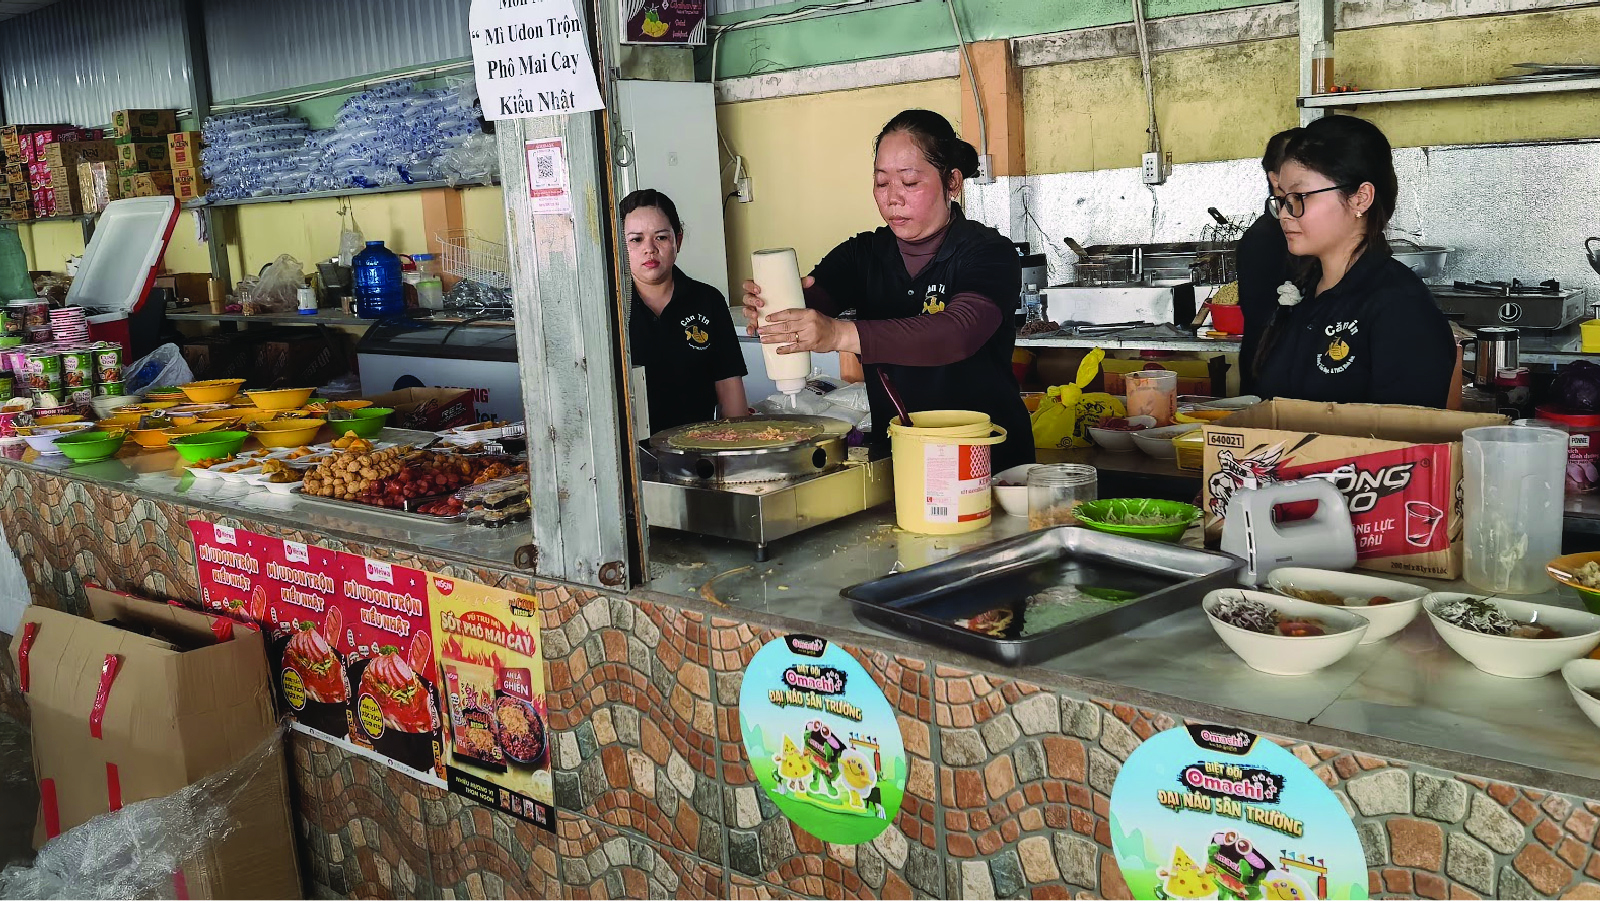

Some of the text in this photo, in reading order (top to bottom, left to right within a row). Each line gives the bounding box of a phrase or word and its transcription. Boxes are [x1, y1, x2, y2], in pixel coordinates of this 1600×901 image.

[508, 23, 543, 42] Udon
[547, 14, 580, 39] Trộn
[487, 51, 580, 80] Phô Mai Cay
[500, 88, 575, 116] Kiểu Nhật
[1211, 435, 1240, 446] 640021
[1374, 518, 1395, 534] LỰC
[210, 547, 235, 568] UDON
[234, 553, 259, 574] TRỘN
[267, 561, 334, 594] MÌ UDON TRỘN
[300, 593, 324, 612] NHẬT
[344, 579, 423, 616] MÌ UDON TRỘN
[361, 606, 409, 637] KIỂU NHẬT
[463, 619, 484, 640] PHÔ
[485, 627, 506, 648] MAI
[507, 633, 531, 656] CAY
[786, 669, 834, 693] Omachi
[1201, 730, 1243, 747] Omachi
[1186, 767, 1264, 800] Omachi
[1216, 796, 1241, 818] SÂN
[1245, 806, 1304, 838] TRƯỜNG
